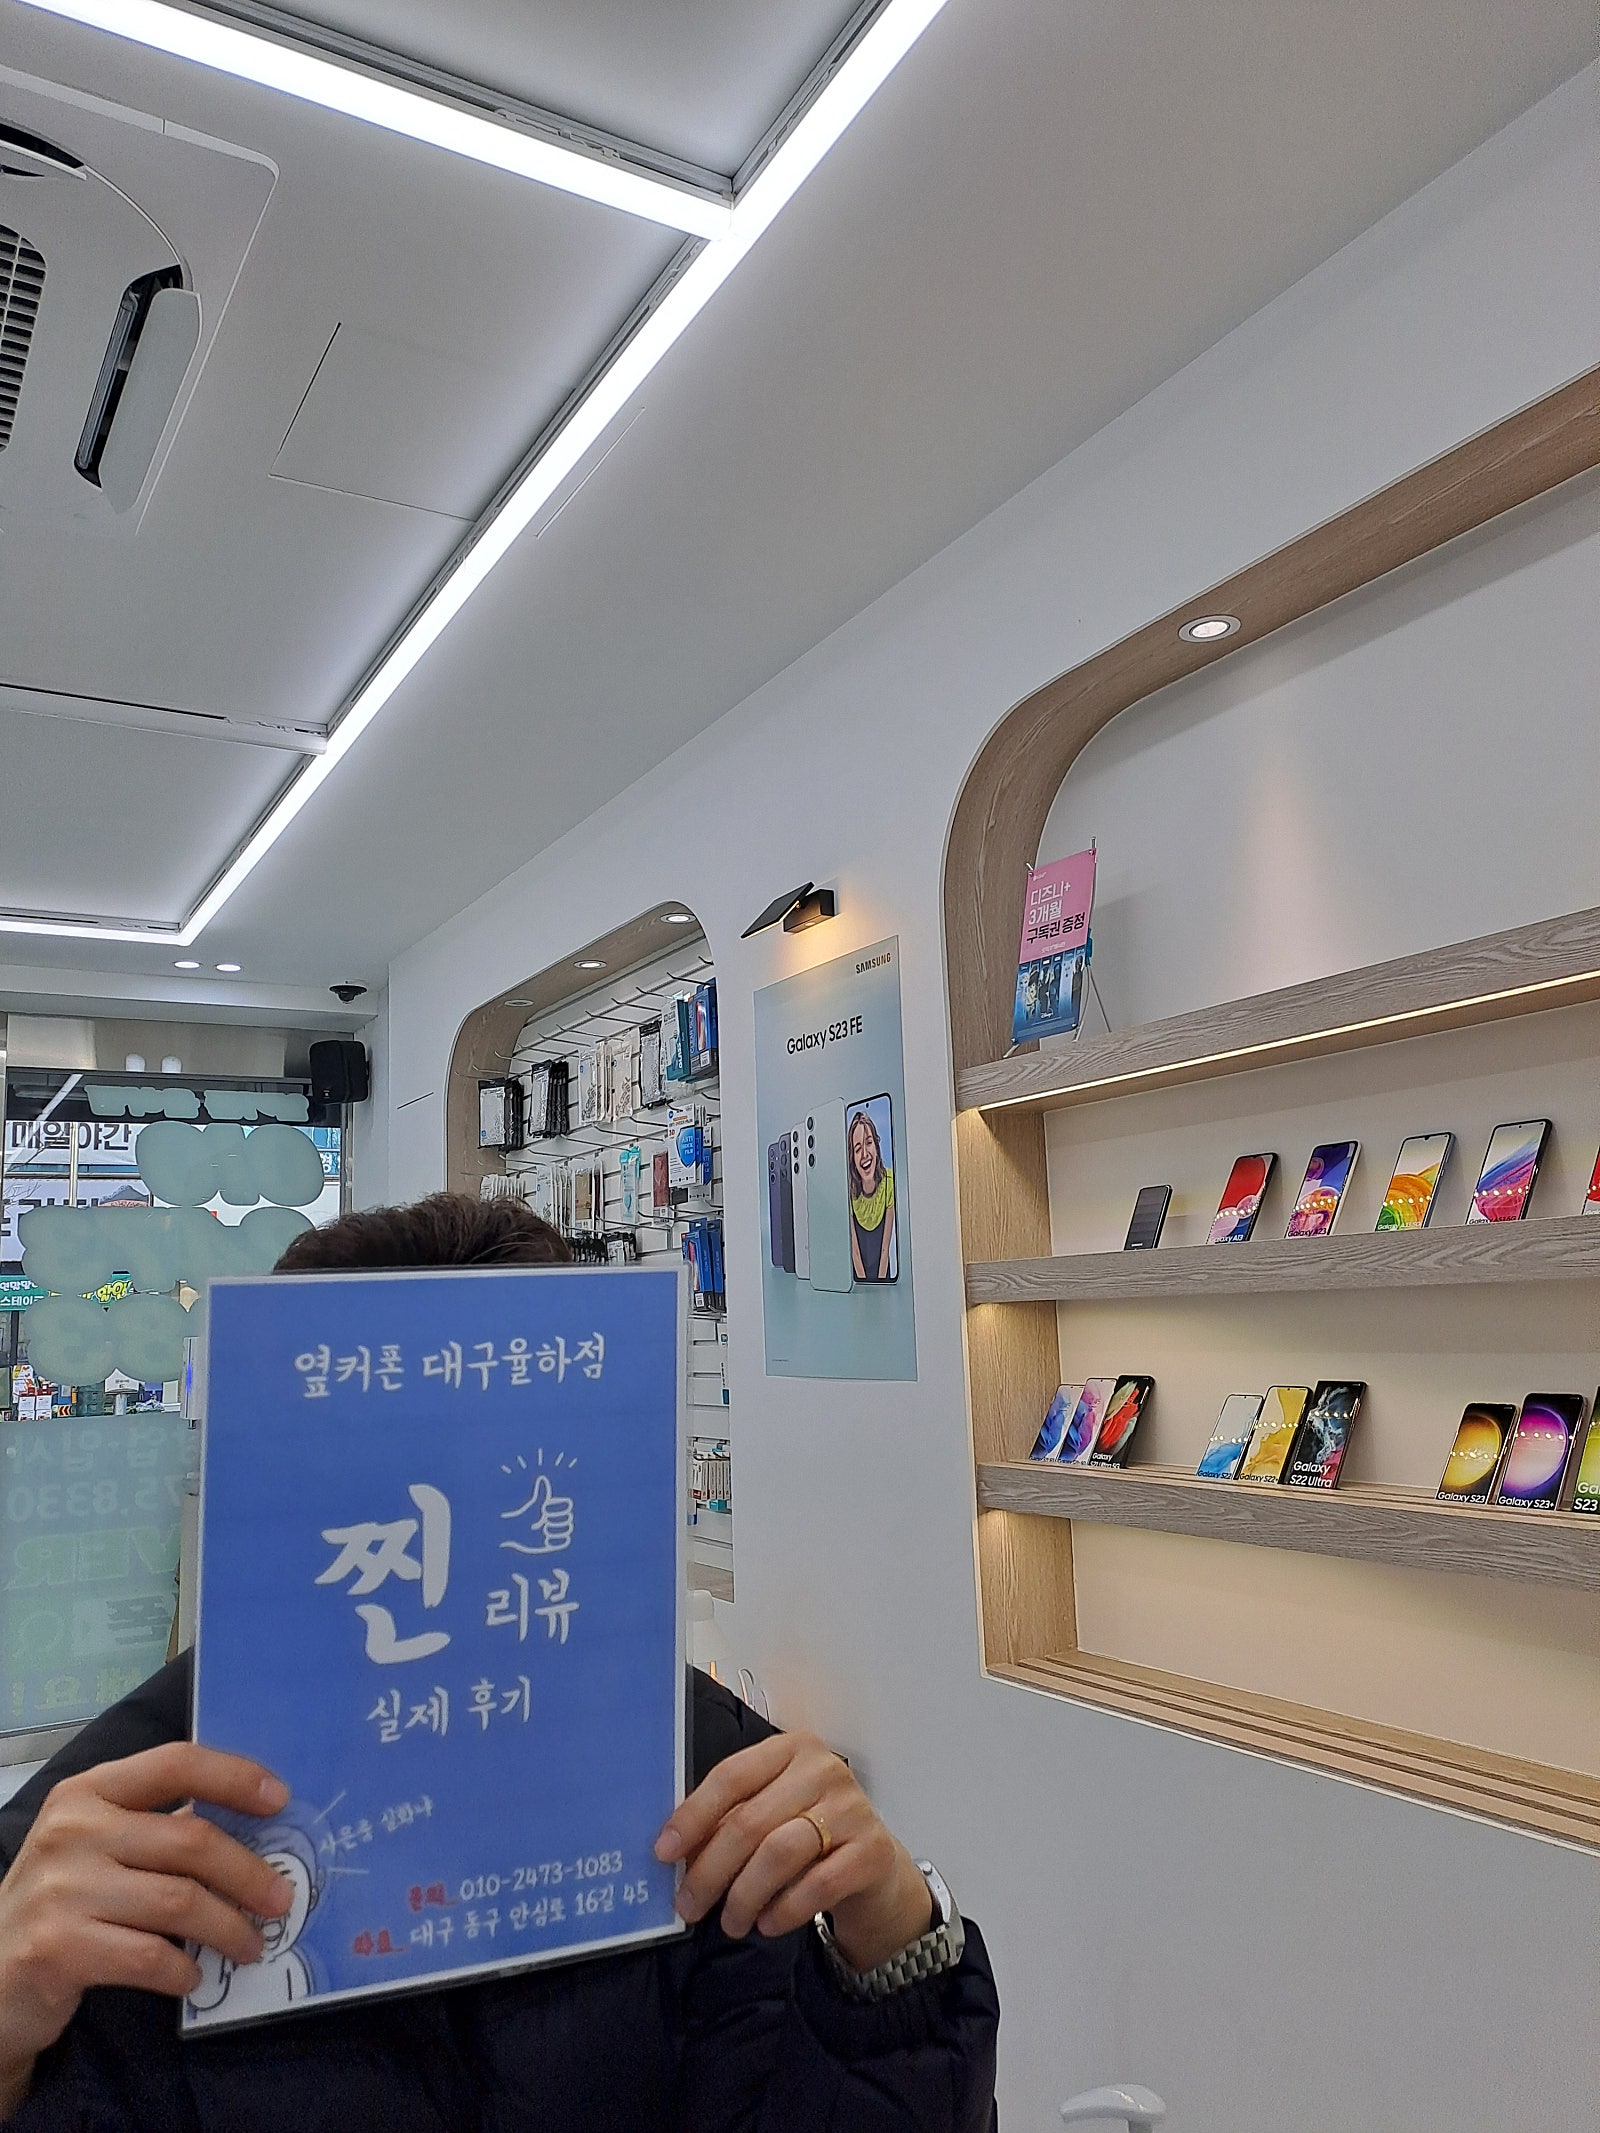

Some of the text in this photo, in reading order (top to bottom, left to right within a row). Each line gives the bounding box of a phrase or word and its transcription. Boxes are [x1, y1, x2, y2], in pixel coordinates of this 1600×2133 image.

[1029, 900, 1062, 925] 3개월
[1027, 912, 1085, 943] 구독권 증정
[855, 952, 891, 974] SAMSUNG
[787, 1015, 863, 1054] Galaxy S23 FE
[1288, 1227, 1327, 1238] Galaxy A23
[294, 1332, 606, 1398] 옆커폰 대구율하점
[1092, 1452, 1114, 1462] Galaxy
[1197, 1470, 1220, 1479] Galaxy
[1240, 1472, 1263, 1482] Galaxy
[1293, 1461, 1331, 1476] Galaxy
[1289, 1475, 1333, 1488] S22 Ultra
[1438, 1491, 1486, 1504] Galaxy S23
[1498, 1496, 1555, 1509] Galaxy S23+
[1573, 1498, 1598, 1511] S23
[314, 1483, 451, 1665] 찐
[485, 1568, 580, 1645] 리뷰
[367, 1675, 532, 1743] 실제 후기
[460, 1850, 623, 1901] 010-2473-1083
[410, 1917, 454, 1947] 대구
[464, 1909, 501, 1939] 동구
[509, 1898, 567, 1930] 안심로
[576, 1884, 615, 1915] 16길
[623, 1879, 649, 1904] 45
